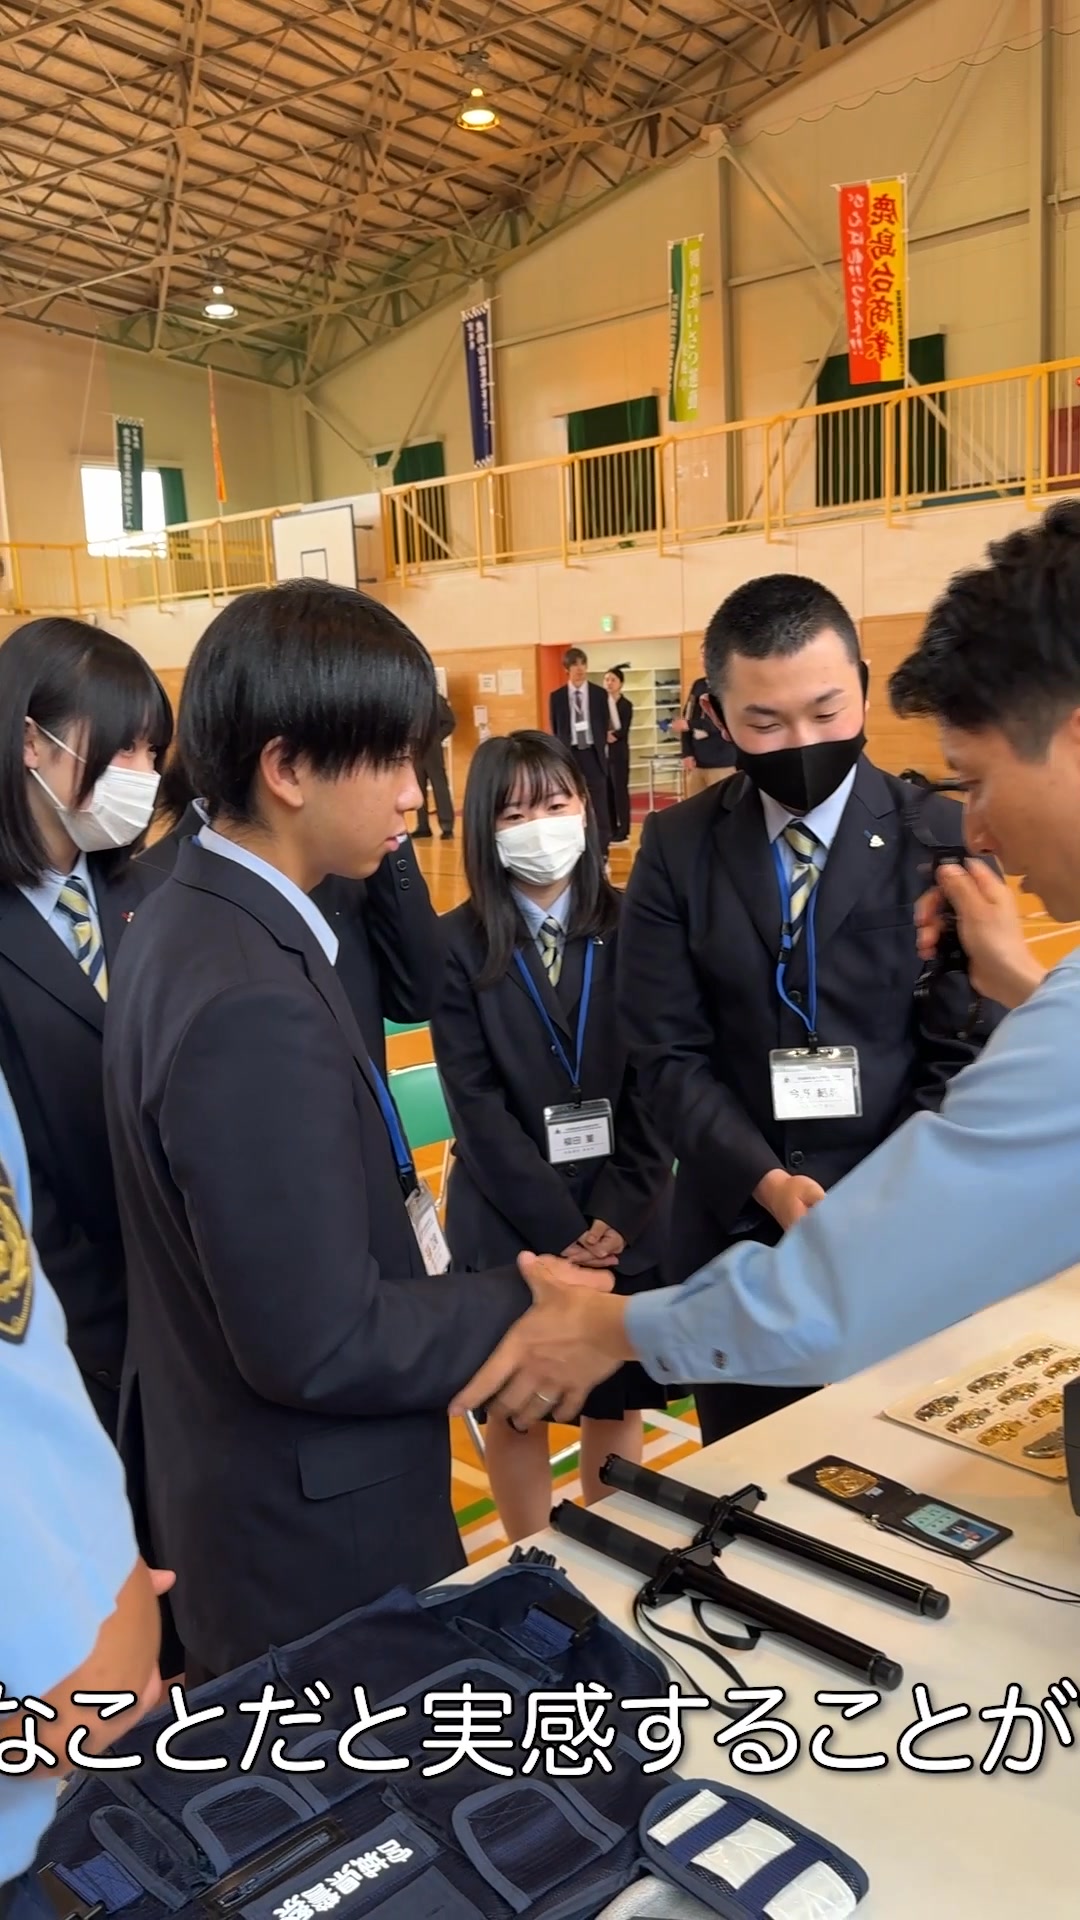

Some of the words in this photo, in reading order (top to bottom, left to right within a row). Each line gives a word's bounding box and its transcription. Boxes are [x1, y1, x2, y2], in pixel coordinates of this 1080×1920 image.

[272, 1838, 414, 1920] 宮城県警察
